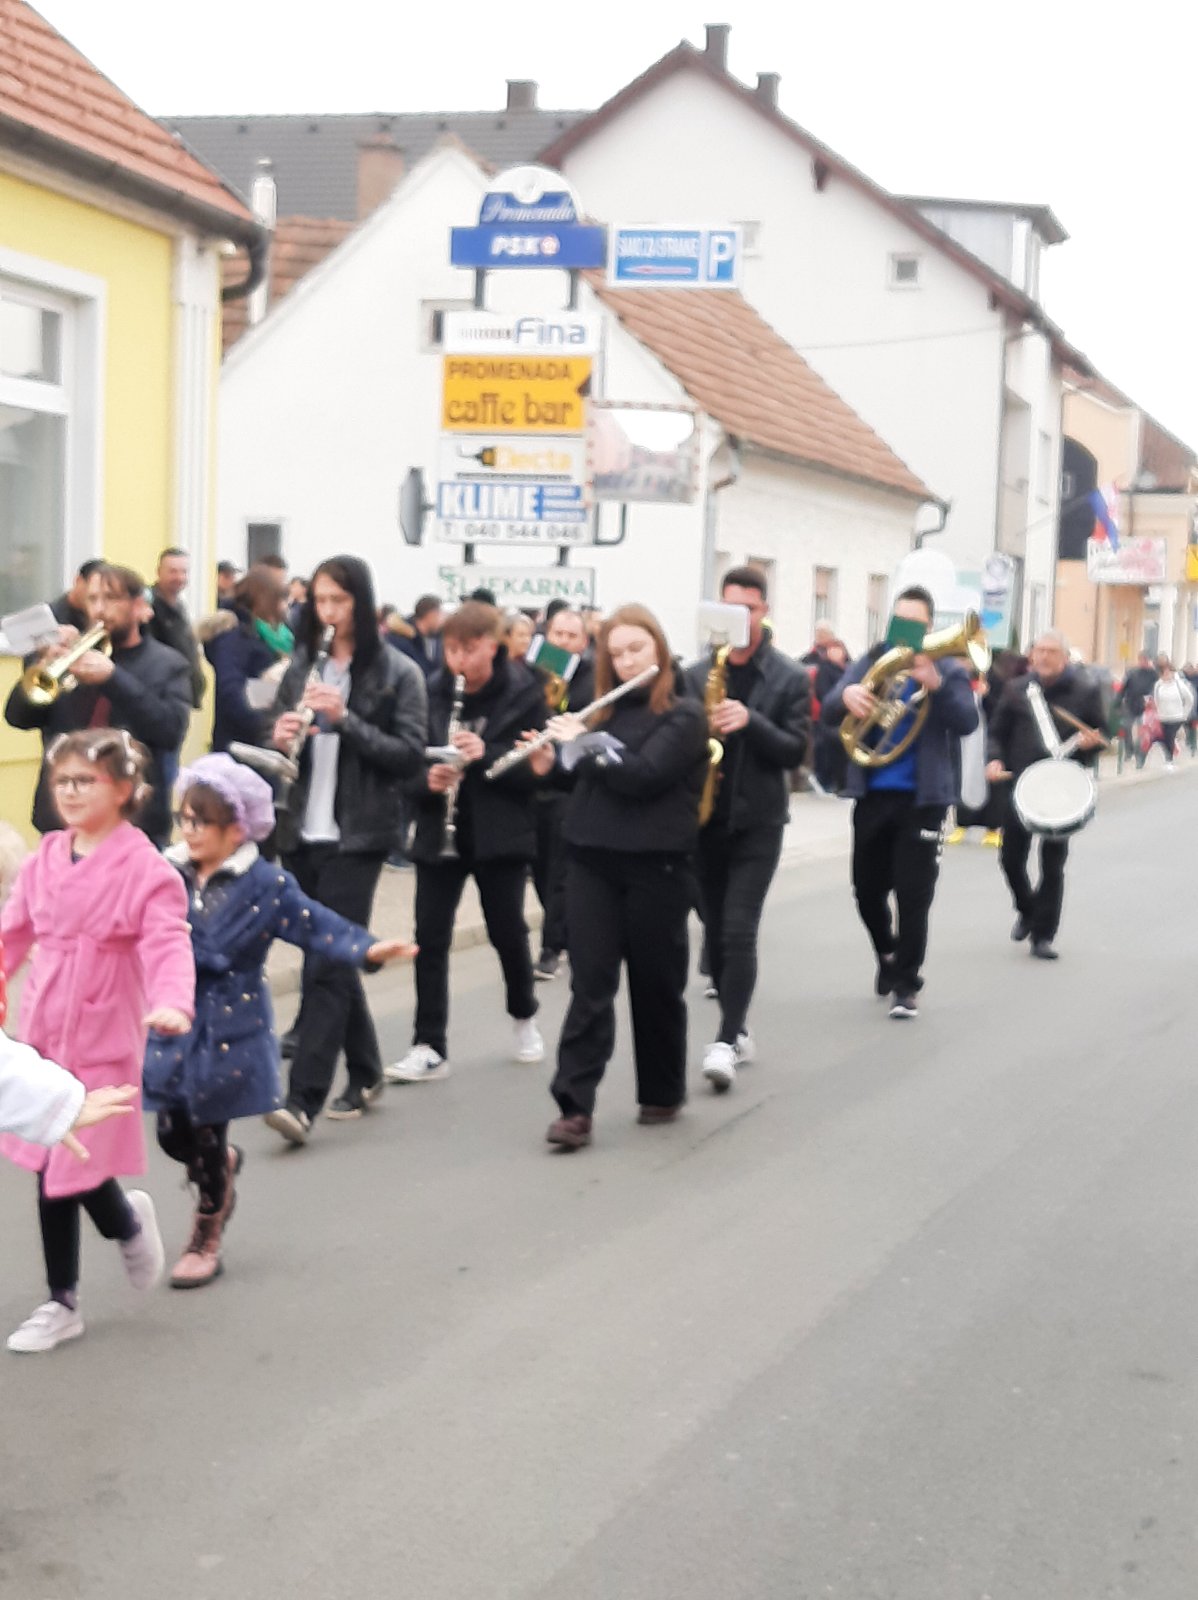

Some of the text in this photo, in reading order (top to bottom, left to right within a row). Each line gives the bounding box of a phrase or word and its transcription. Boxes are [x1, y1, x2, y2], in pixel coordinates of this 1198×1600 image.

[709, 236, 734, 280] P
[516, 317, 586, 345] Fina
[449, 361, 571, 381] PROMENADA
[448, 392, 573, 425] caffe bar
[464, 523, 498, 537] 040
[506, 524, 541, 538] 544
[461, 576, 586, 595] LJEKARNA
